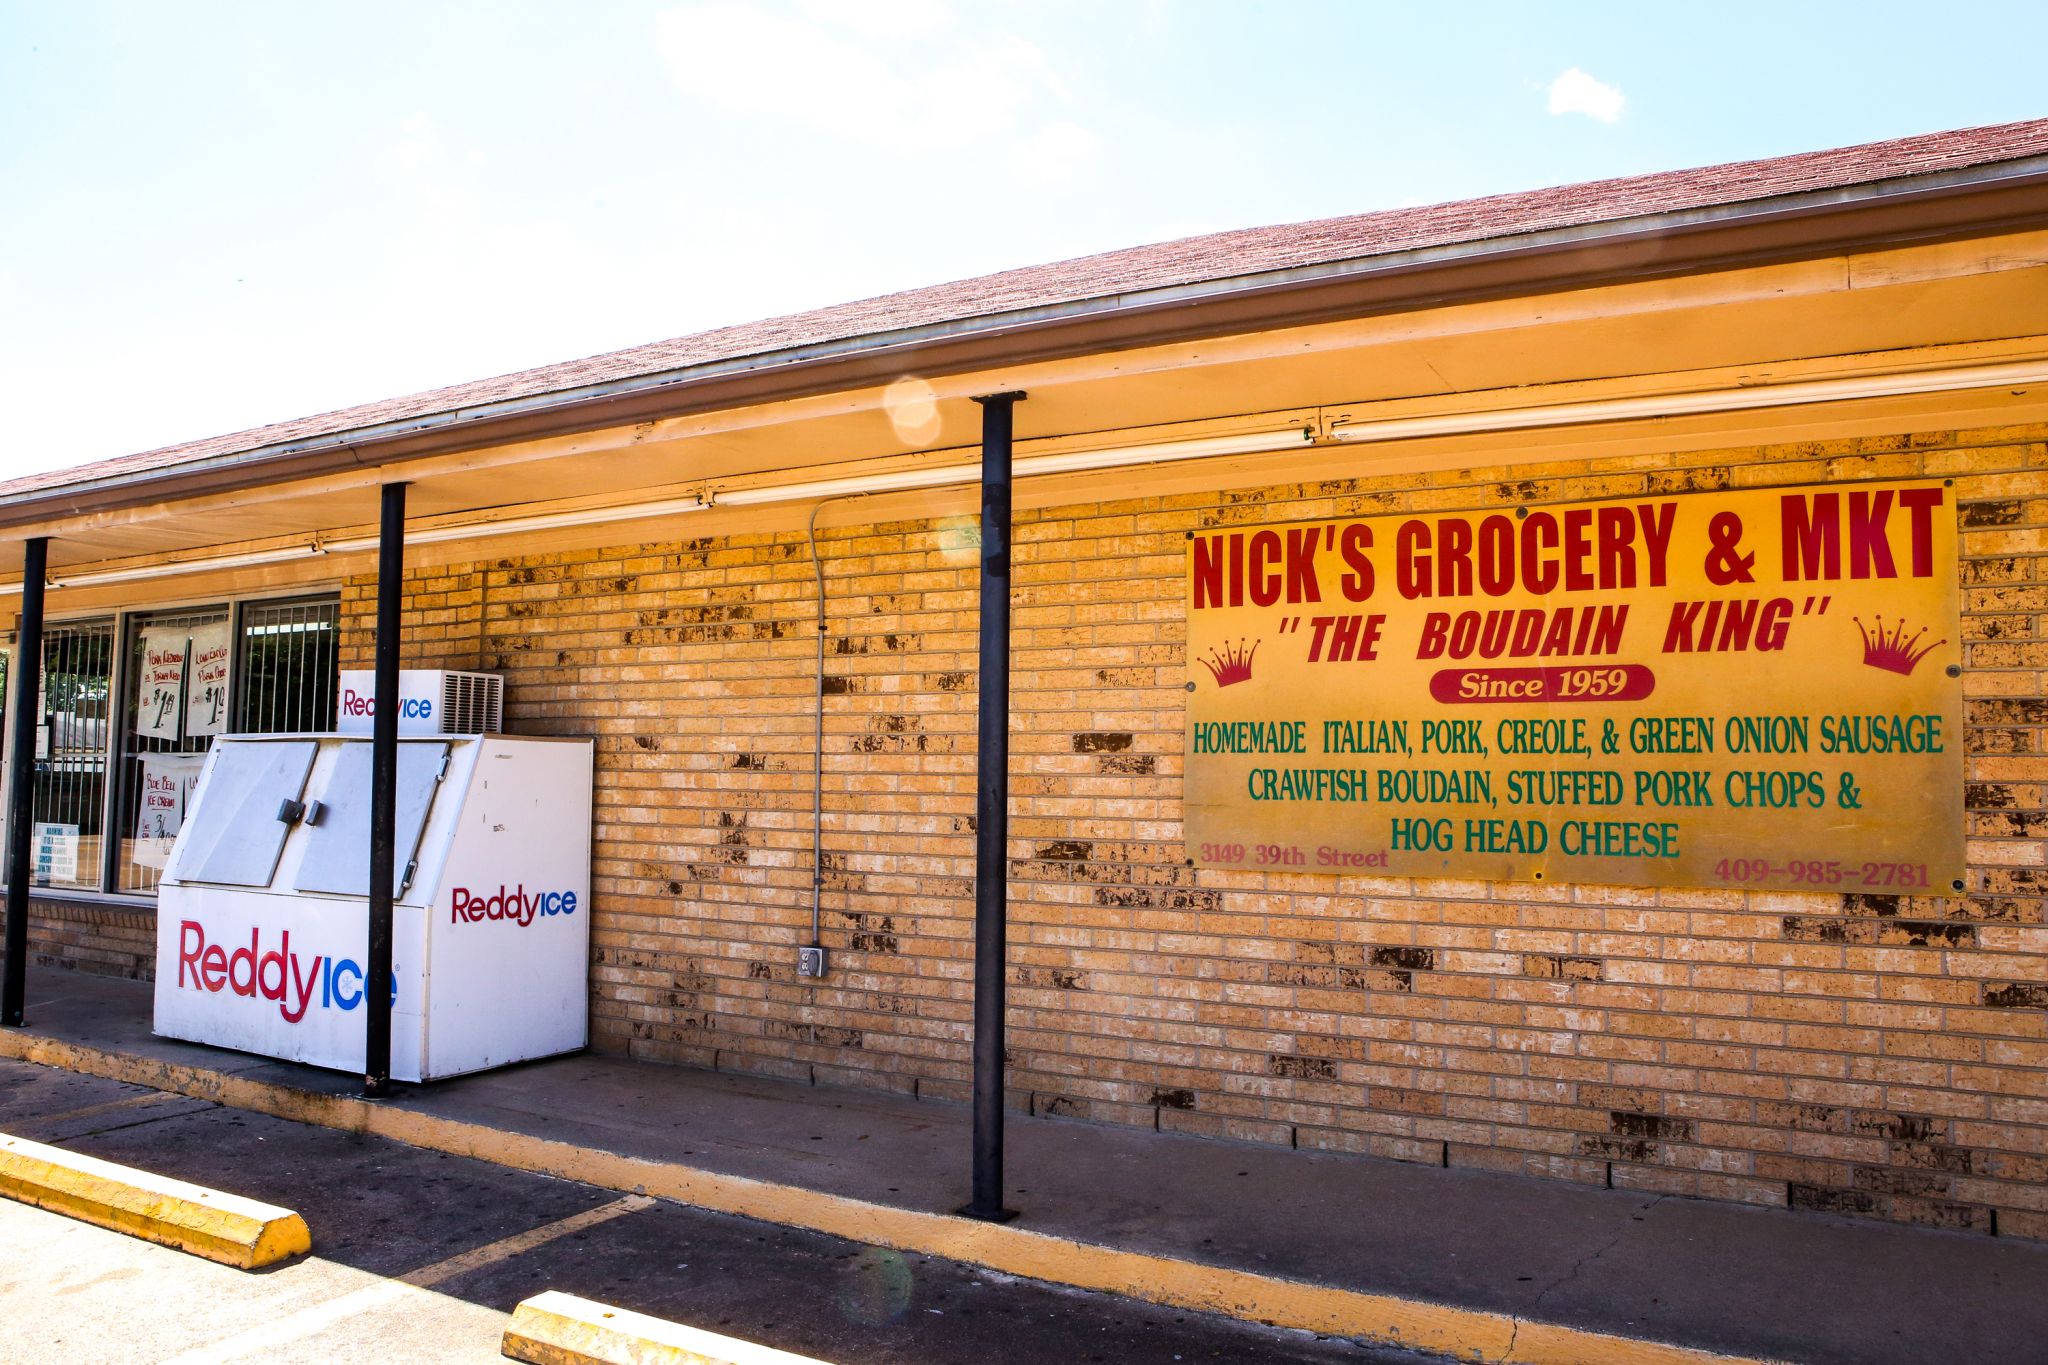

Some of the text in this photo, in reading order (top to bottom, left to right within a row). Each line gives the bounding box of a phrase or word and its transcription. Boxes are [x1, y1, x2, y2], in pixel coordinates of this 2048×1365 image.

[1194, 488, 1943, 609] NICK'S GROCERY & MKT
[1416, 604, 1629, 660] BOUDAIN
[1459, 670, 1627, 698] Since 1959
[1194, 715, 1944, 759] HOMEMADE ITALIAN, PORK, CREOLE, & GREEN ONION SAUSAGE
[1249, 769, 1862, 809] CRAWFISH BOUDAIN, STUFFED PORK CHOPS &
[1201, 844, 1388, 867] 3149 39th Street
[1392, 818, 1680, 857] HOG HEAD CHEESE
[1714, 858, 1931, 888] 409-985-2781
